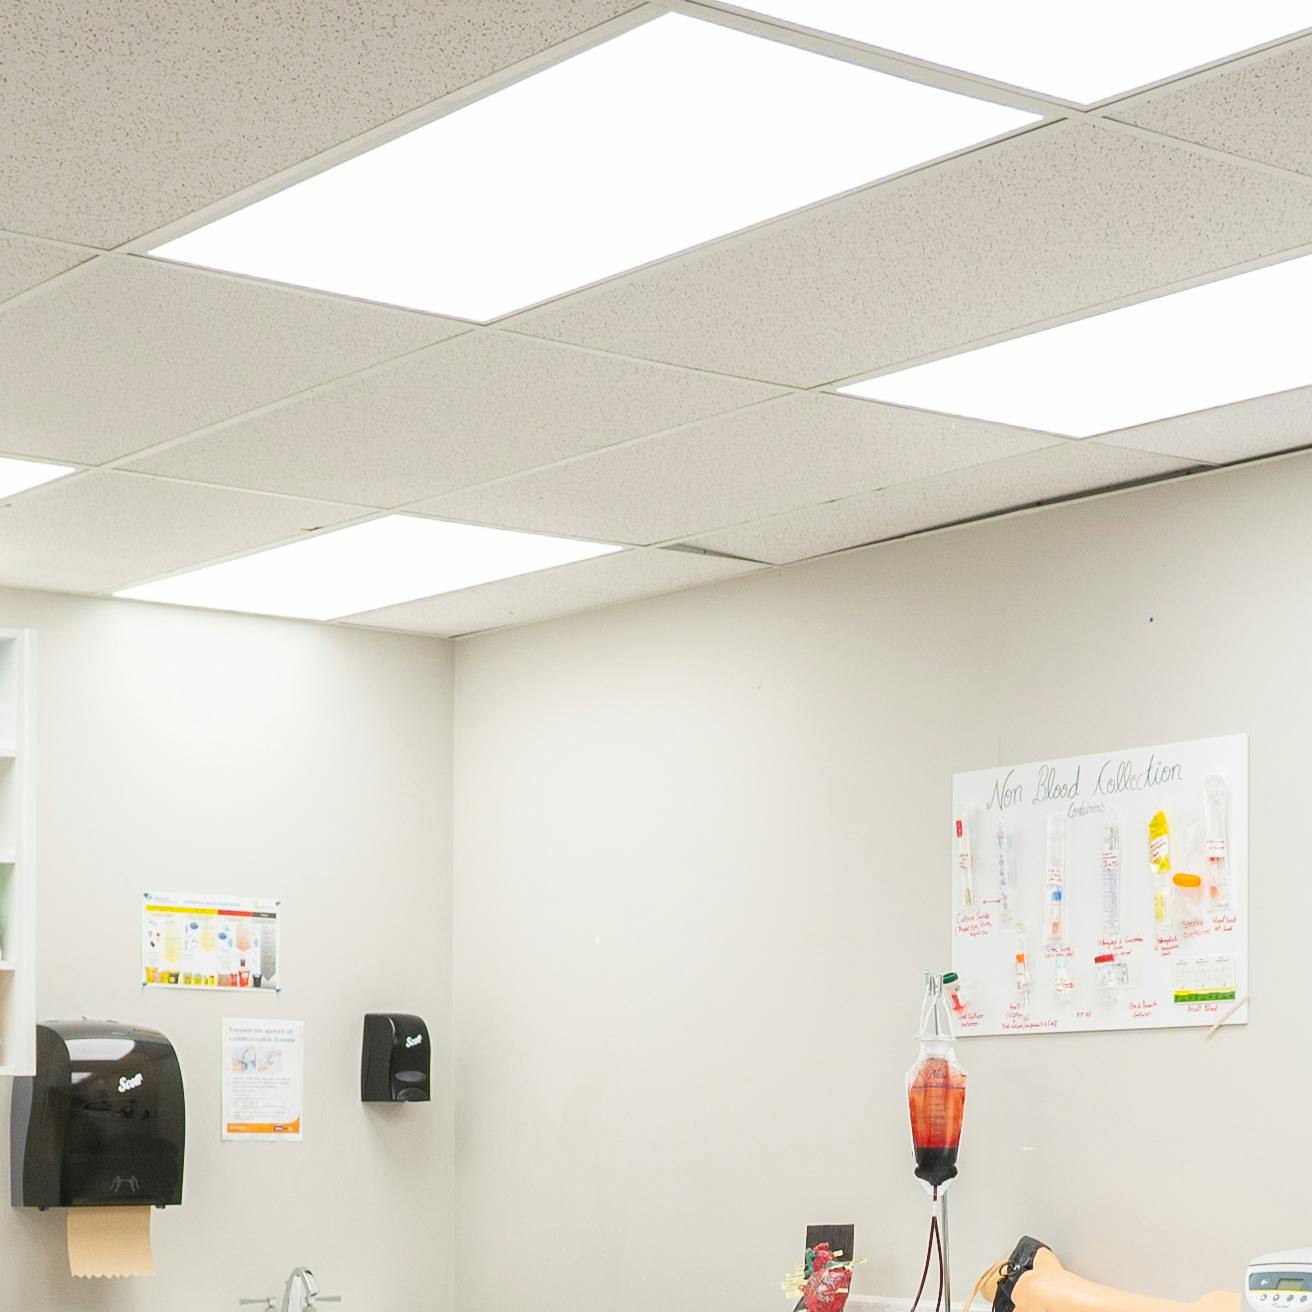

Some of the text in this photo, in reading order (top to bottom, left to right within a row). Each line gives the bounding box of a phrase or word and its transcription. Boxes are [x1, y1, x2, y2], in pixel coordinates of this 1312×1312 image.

[987, 754, 1183, 810] Non Blood Collection
[118, 1073, 144, 1092] Scott
